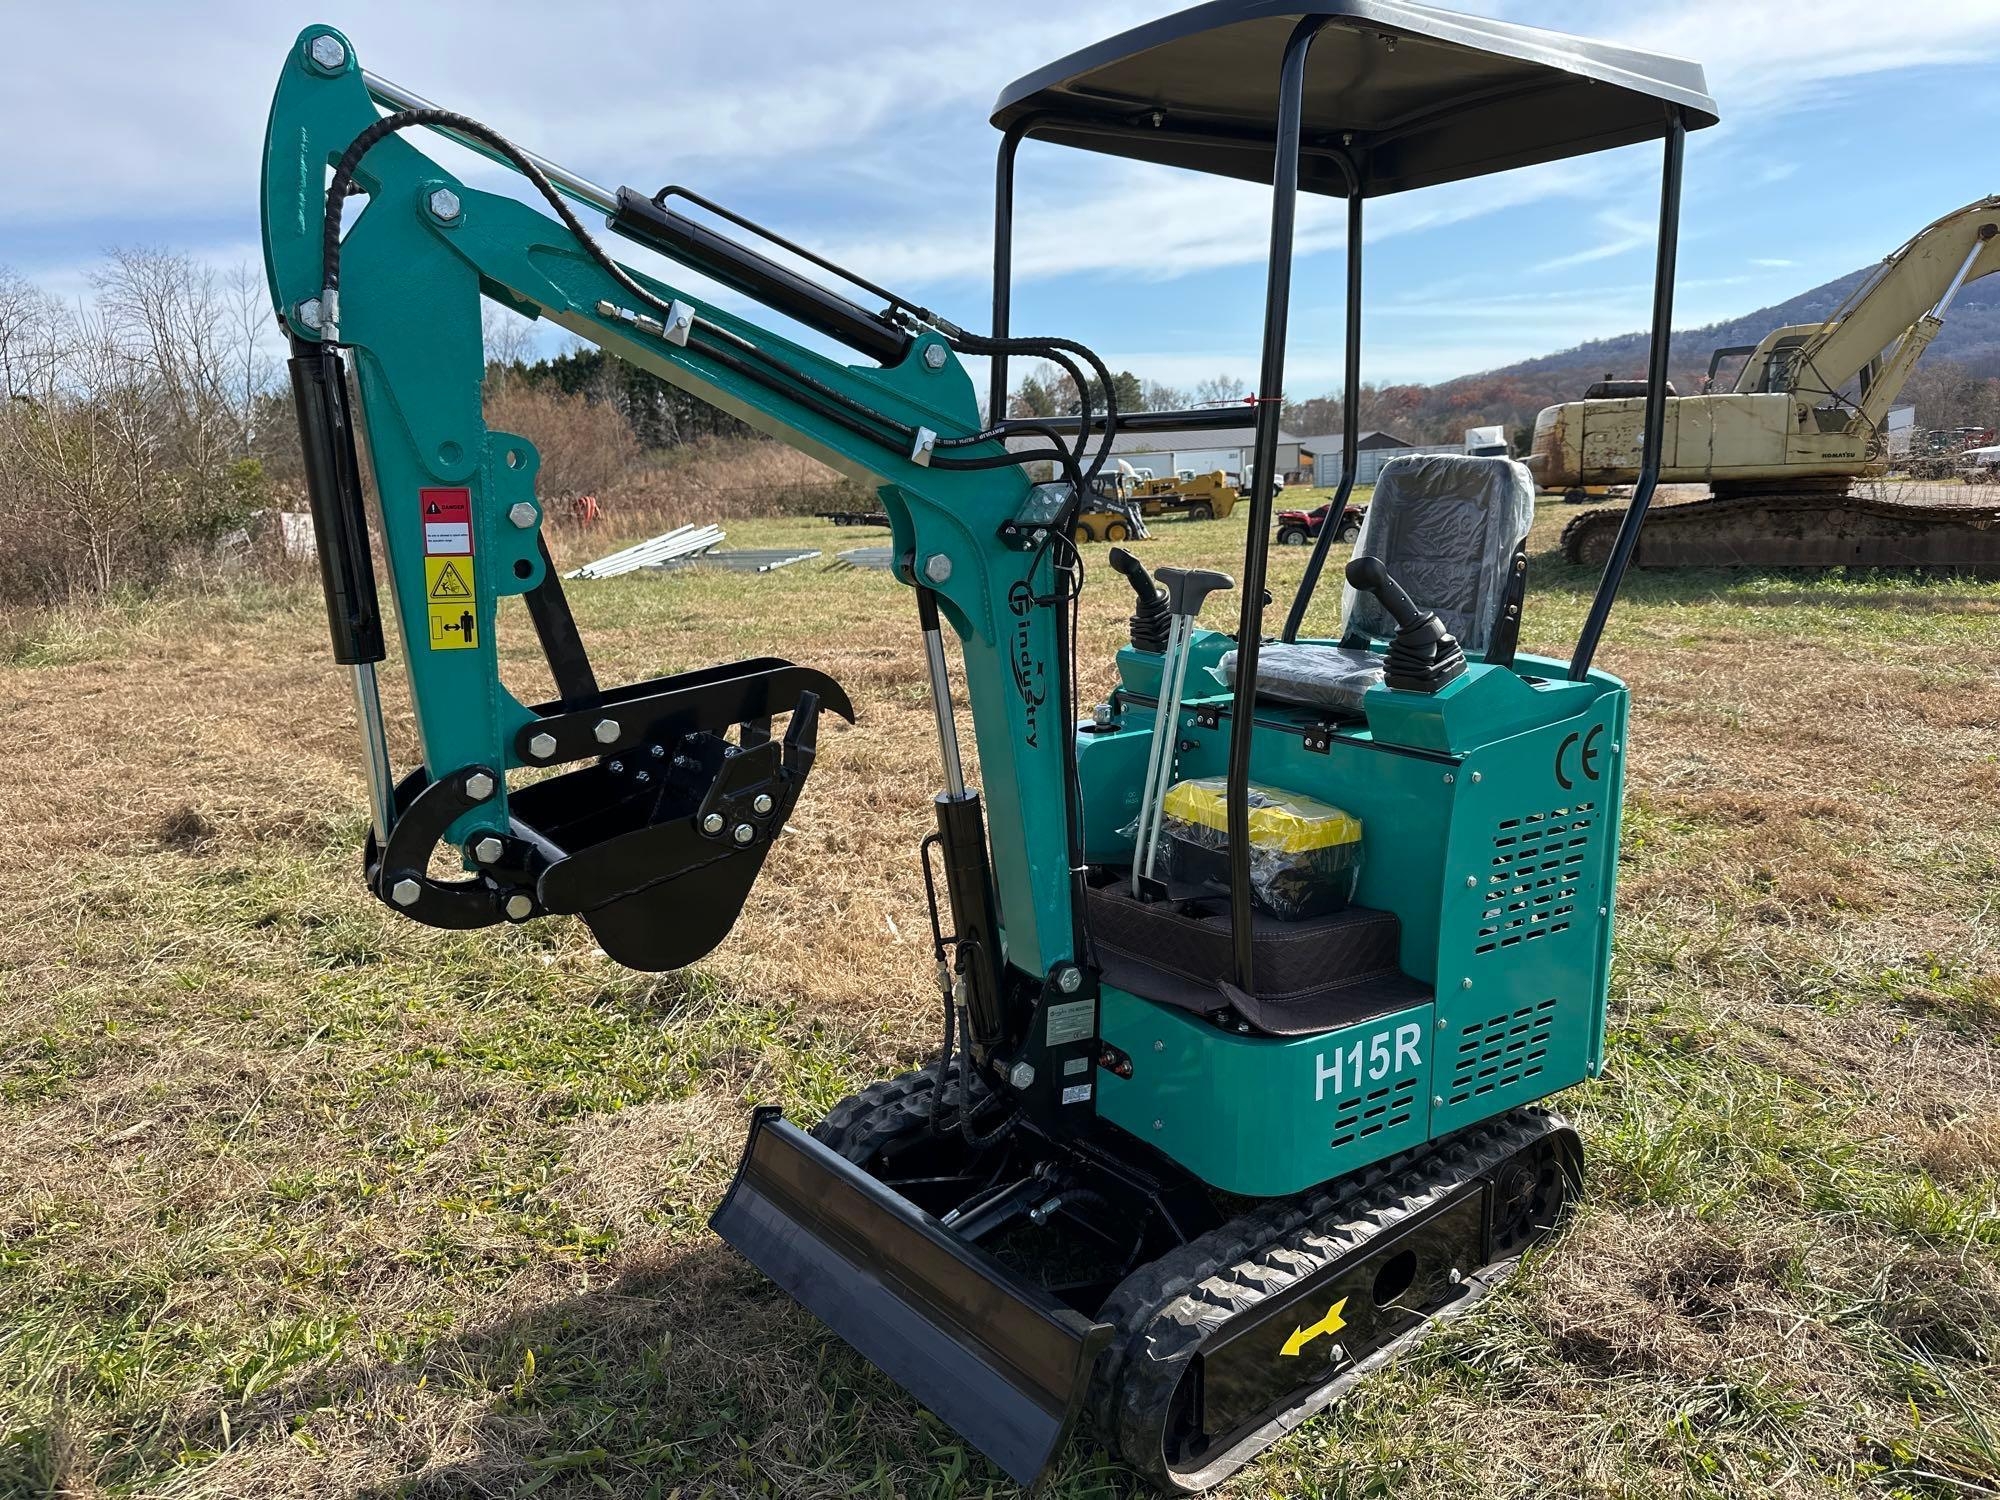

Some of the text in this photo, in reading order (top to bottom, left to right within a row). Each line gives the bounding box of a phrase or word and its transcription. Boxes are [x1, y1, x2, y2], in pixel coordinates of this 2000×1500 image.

[1822, 451, 1856, 459] KOMATSU
[1106, 503, 1125, 513] DEERE
[1555, 723, 1604, 790] CE
[1315, 1022, 1422, 1101] H15R
